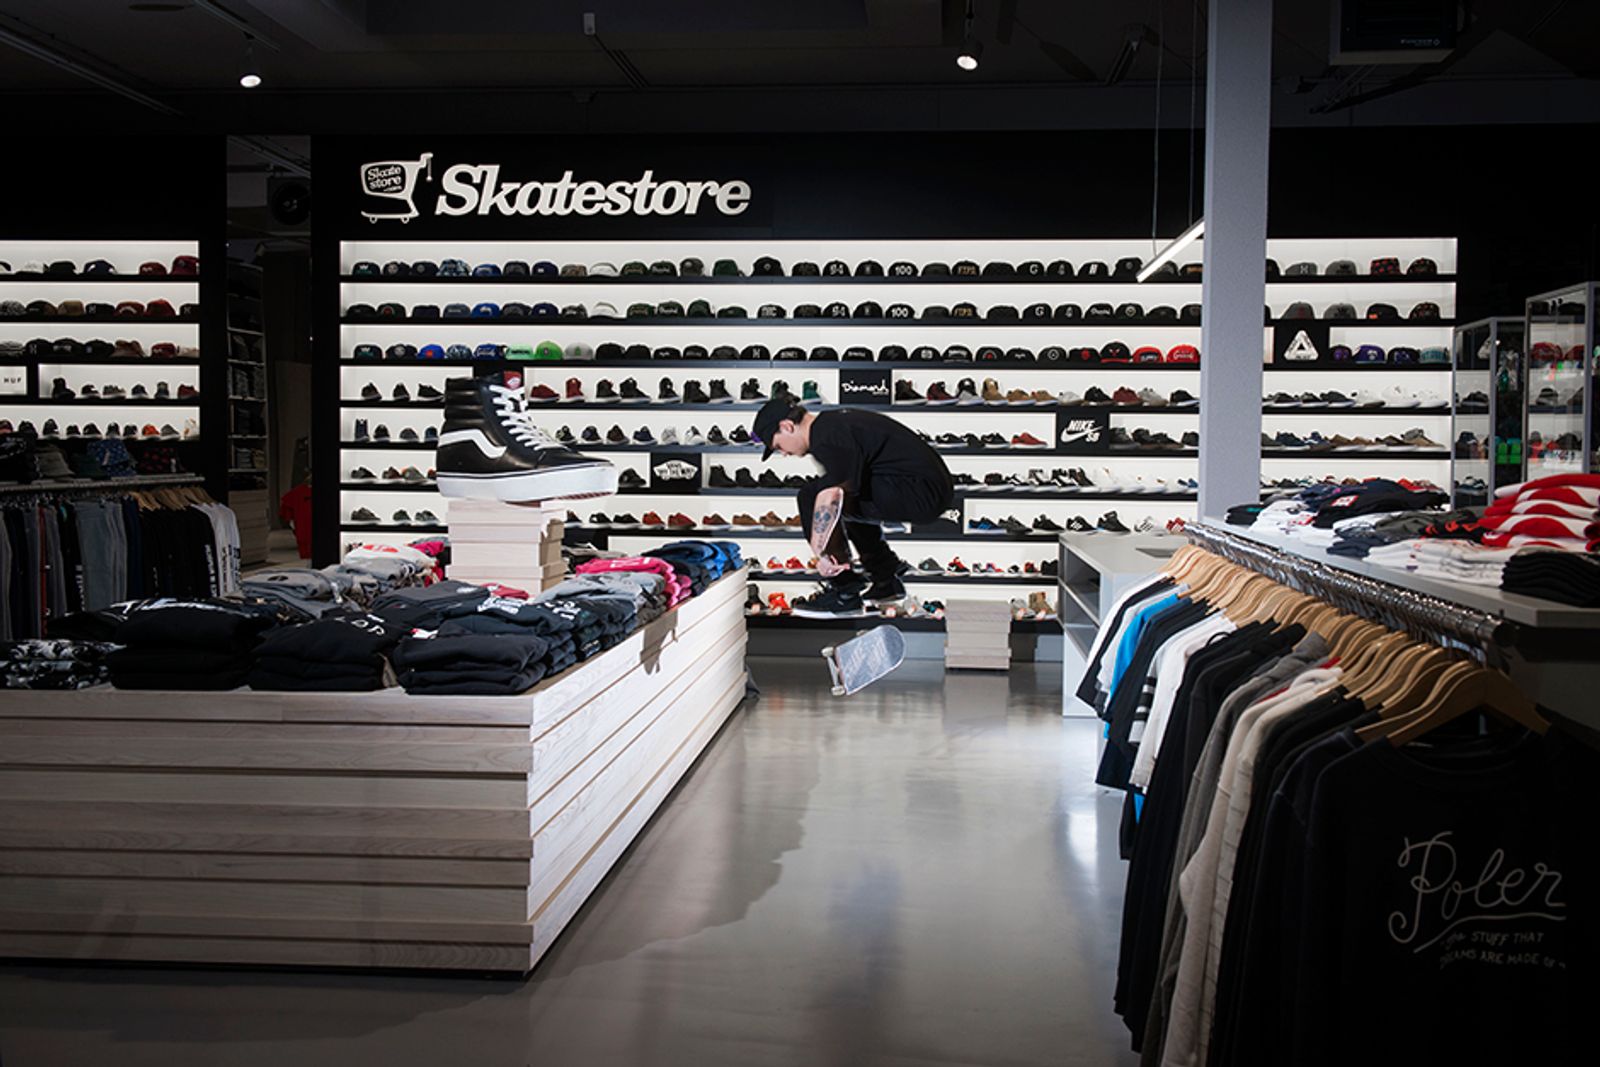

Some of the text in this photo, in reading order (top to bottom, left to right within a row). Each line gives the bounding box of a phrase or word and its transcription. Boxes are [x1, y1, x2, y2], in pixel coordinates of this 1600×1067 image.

[367, 165, 402, 181] Skate
[369, 176, 402, 189] store
[434, 163, 752, 217] Skatestore
[3, 376, 22, 384] HUF
[1067, 419, 1095, 431] NIKE
[1387, 830, 1567, 944] Poler
[1471, 930, 1510, 946] STUFF
[1513, 931, 1545, 945] THAT
[1479, 950, 1505, 965] ARE
[1506, 951, 1540, 965] MADE
